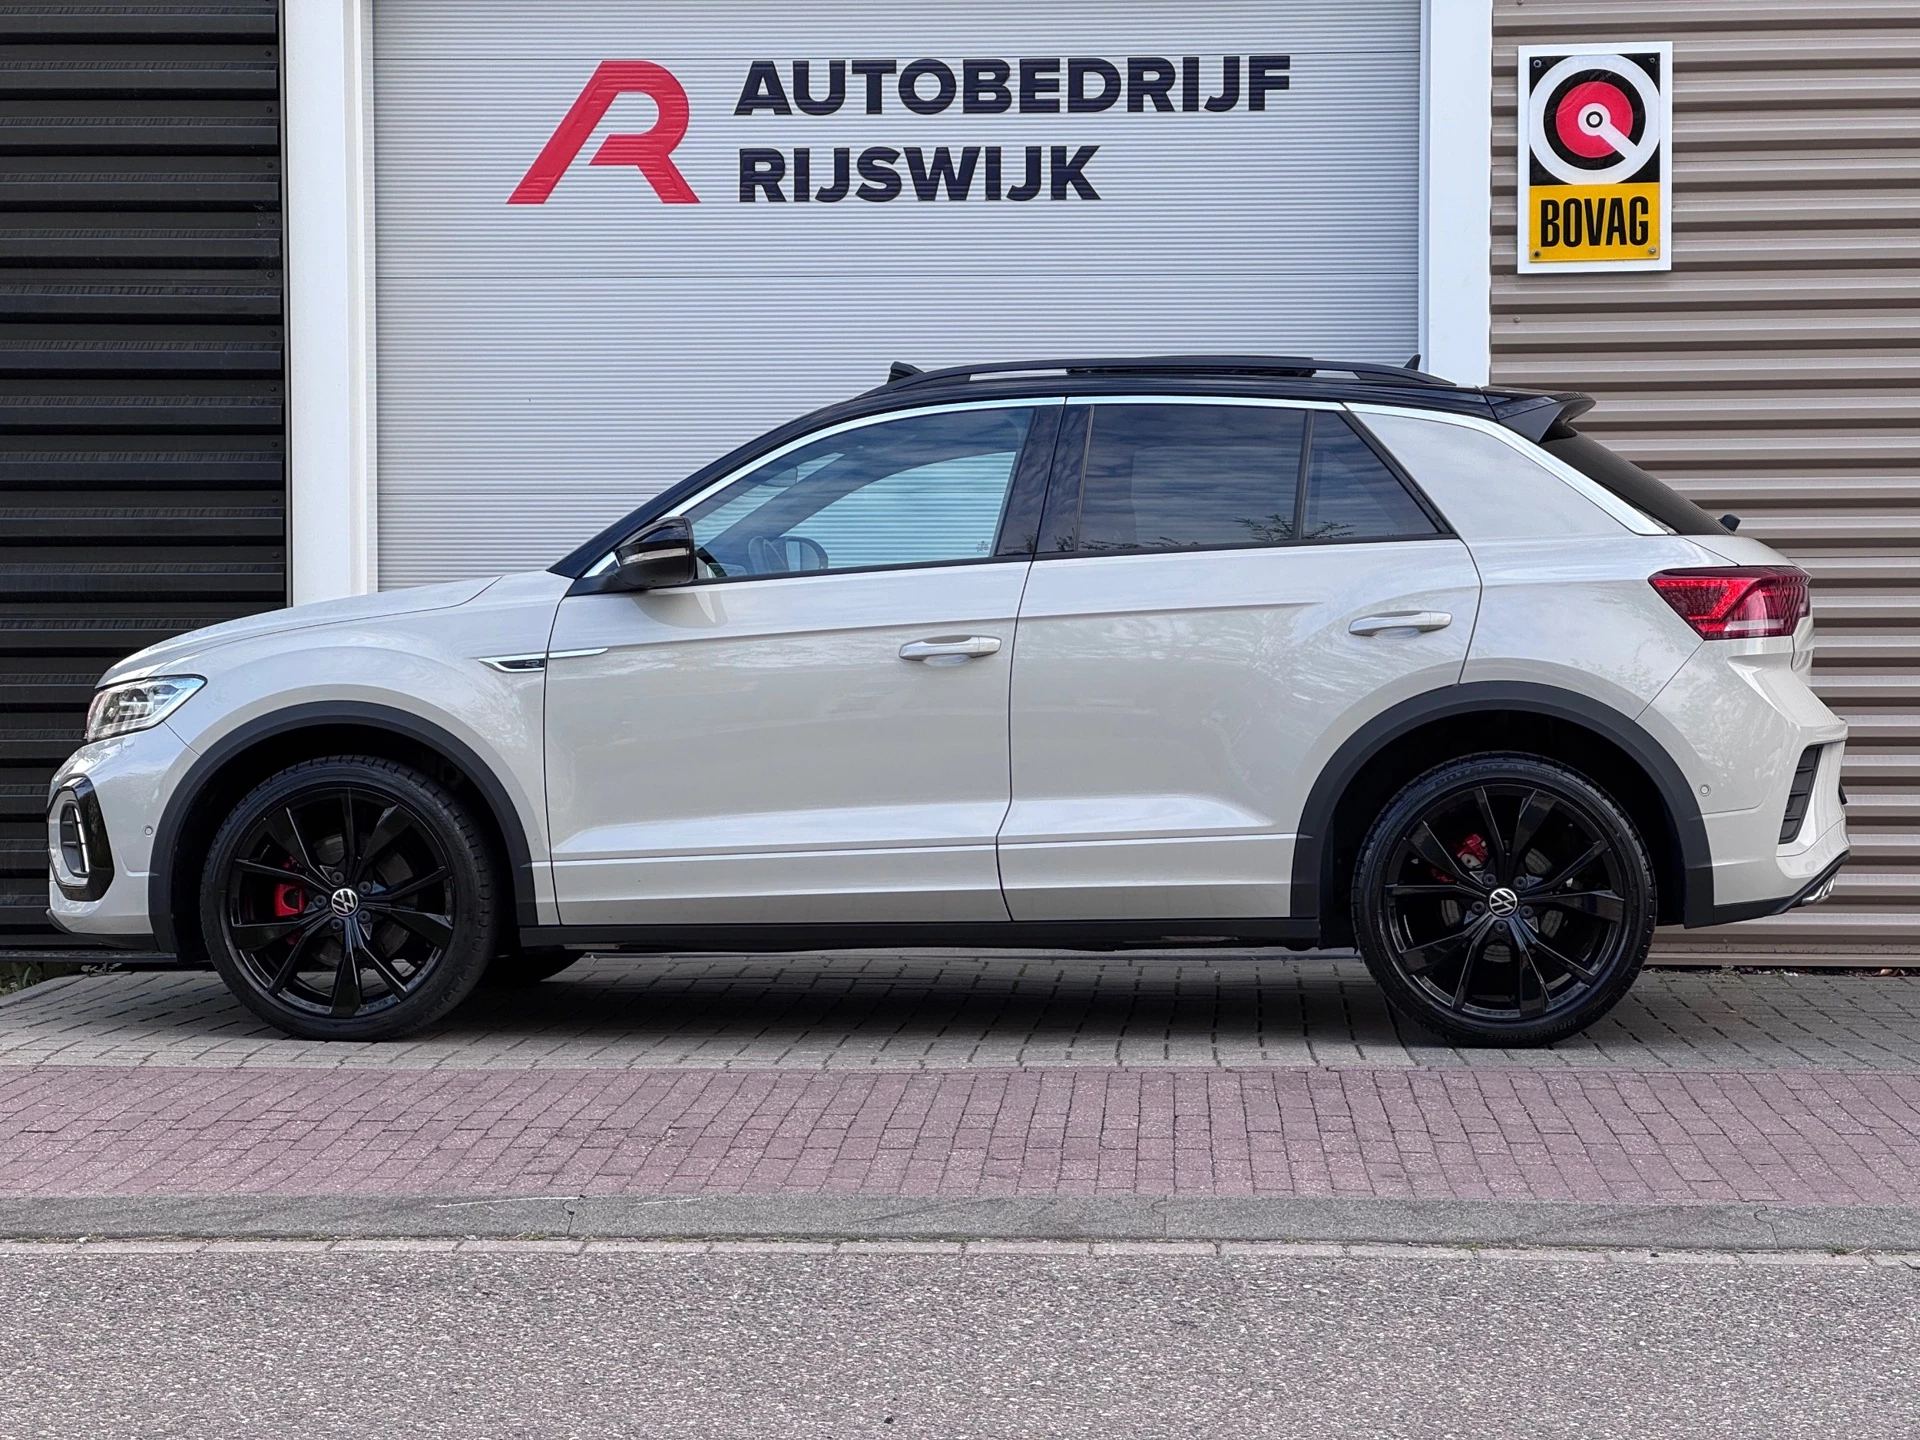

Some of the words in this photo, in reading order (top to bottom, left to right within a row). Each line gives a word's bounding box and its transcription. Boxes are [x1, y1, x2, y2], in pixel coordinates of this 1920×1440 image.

[734, 55, 1290, 116] AUTOBEDRIJF
[739, 146, 1102, 203] RIJSWIJK
[1541, 196, 1649, 248] BOVAG
